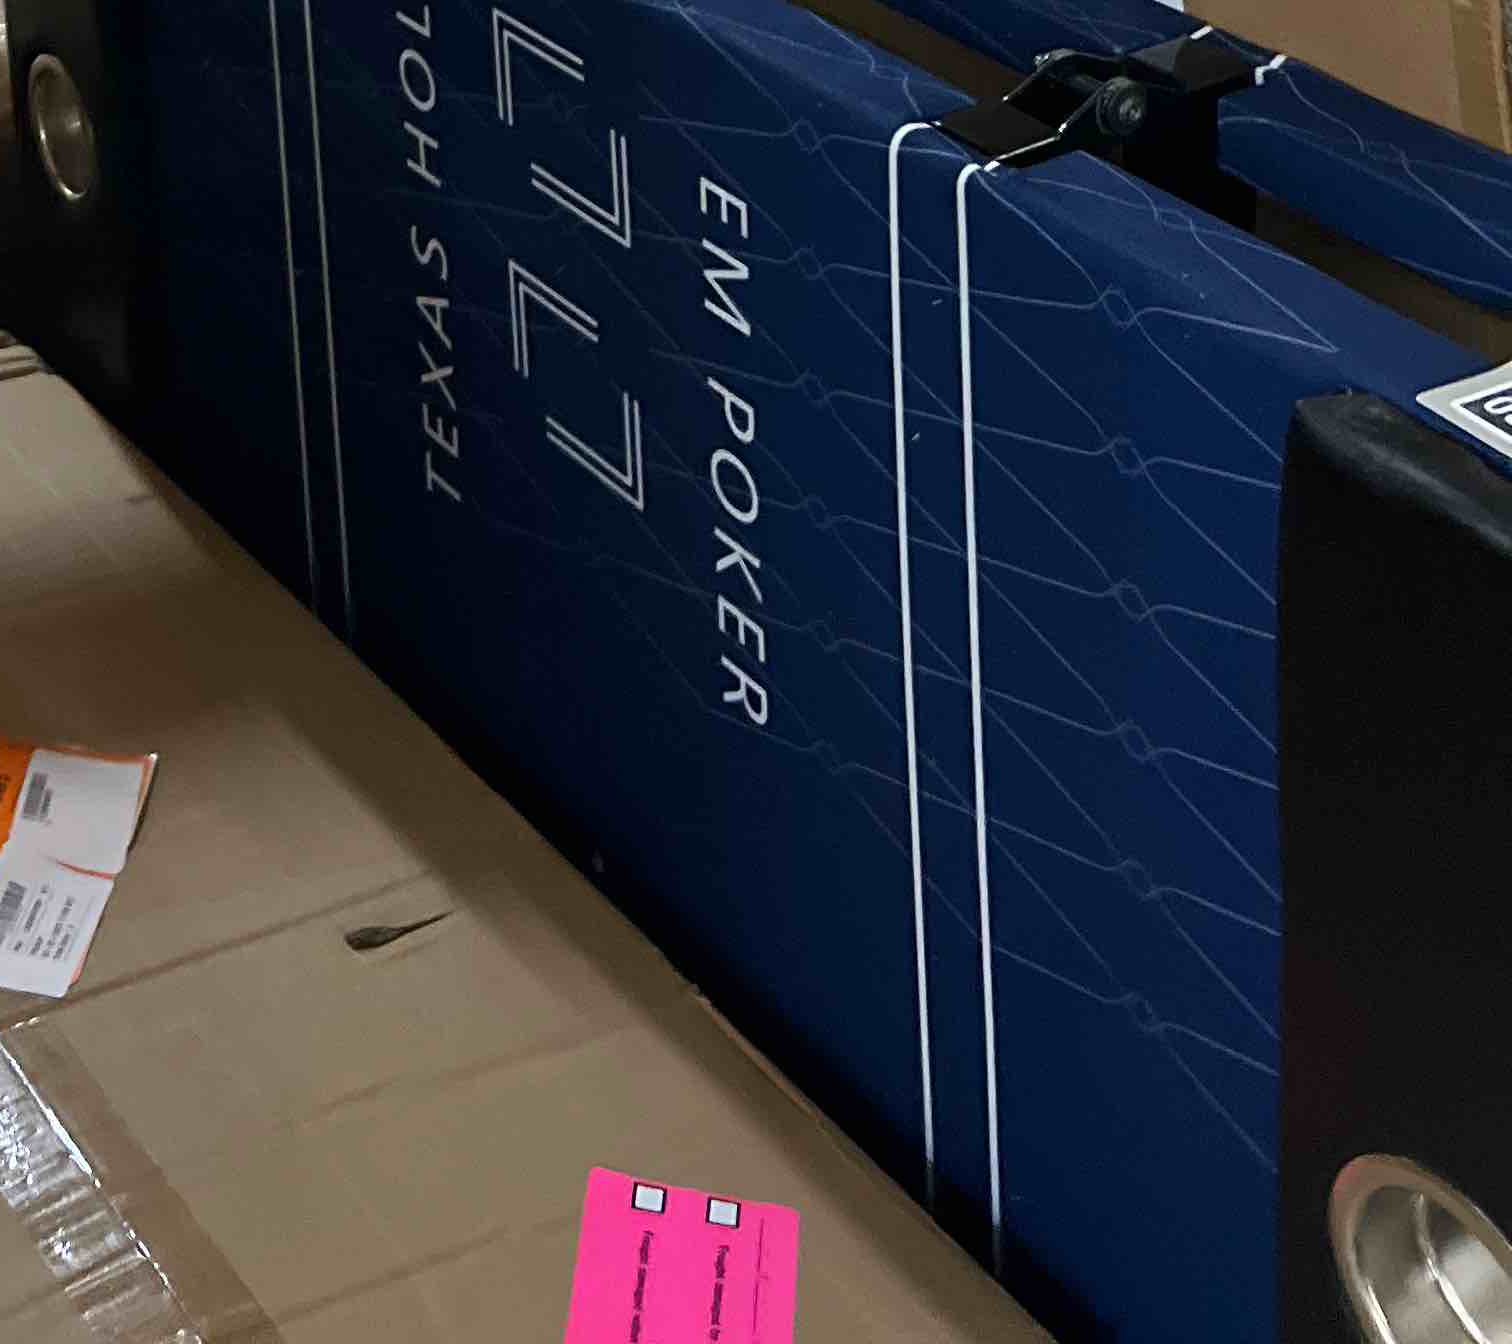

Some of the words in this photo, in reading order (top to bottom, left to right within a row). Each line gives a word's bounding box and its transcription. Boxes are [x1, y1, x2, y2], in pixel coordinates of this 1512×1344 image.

[409, 223, 465, 506] TEXAS
[698, 175, 754, 339] EM
[705, 376, 771, 728] POKER
